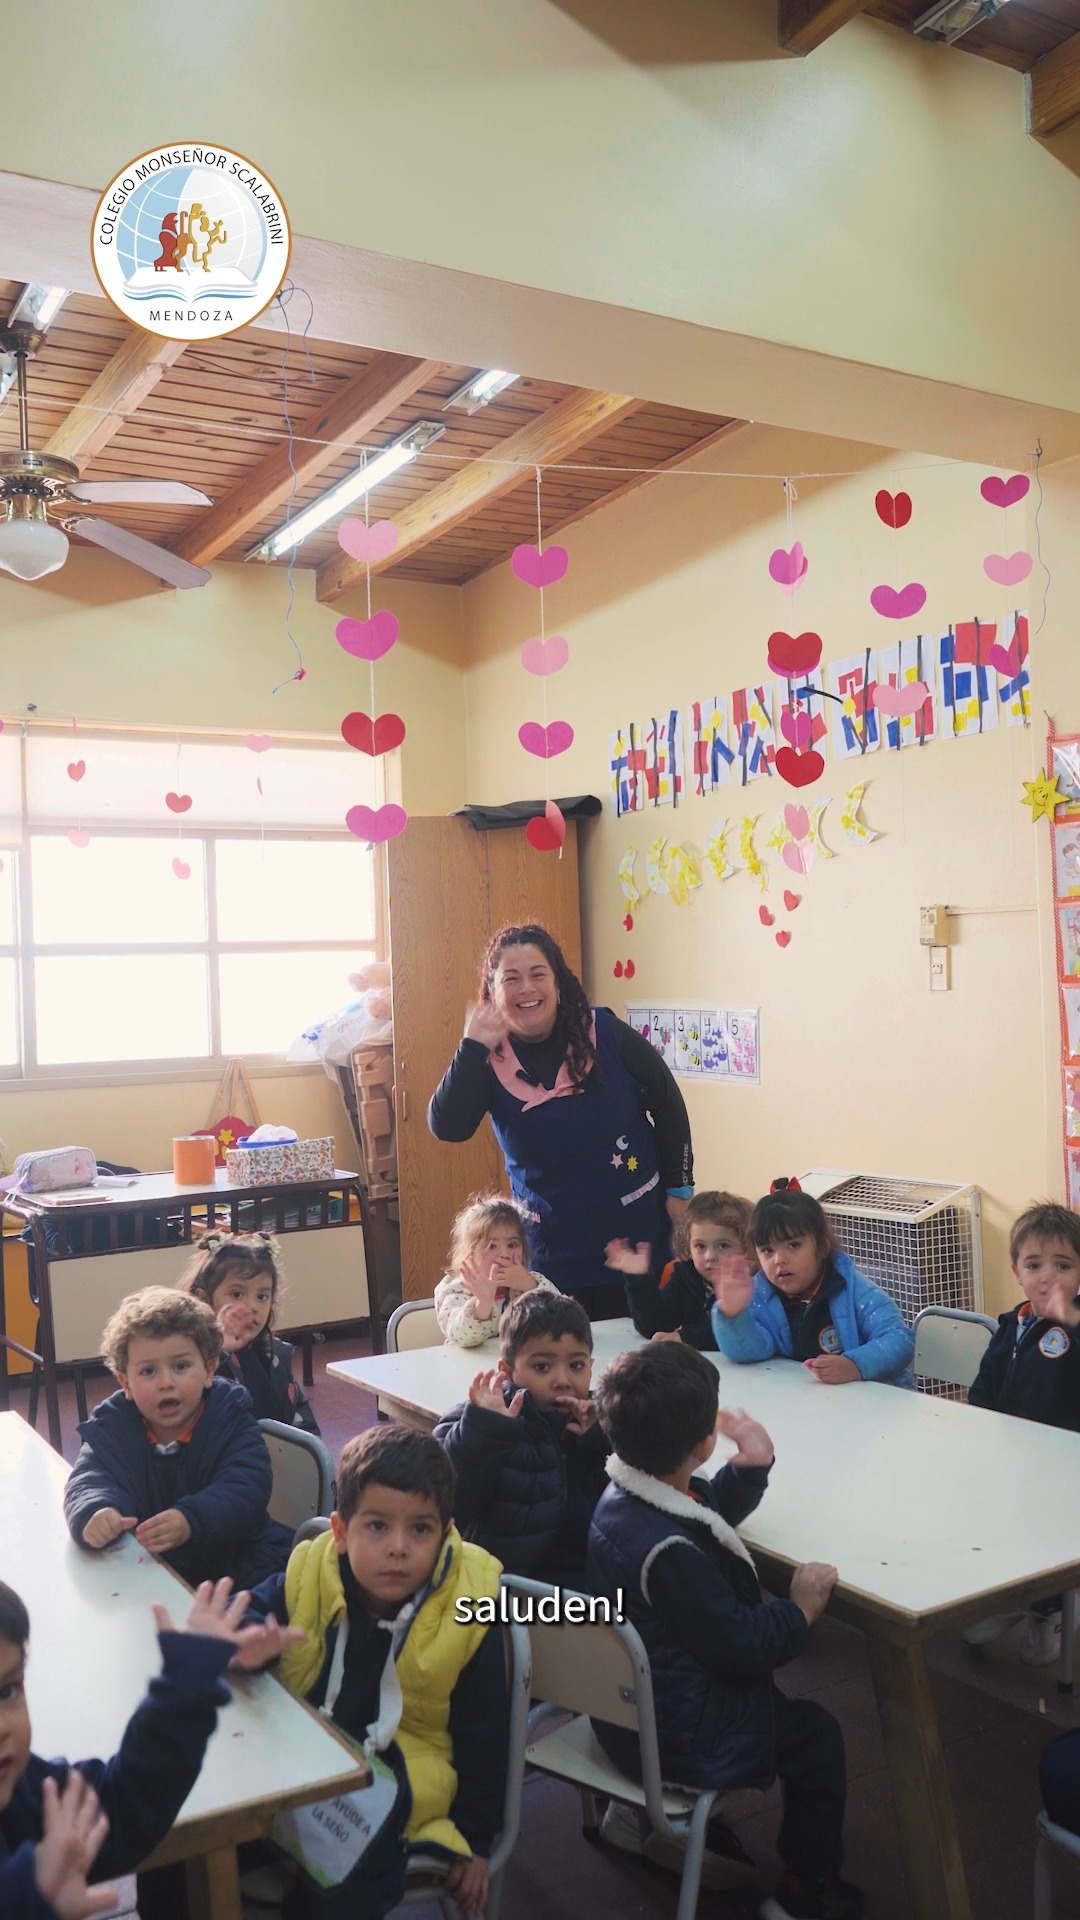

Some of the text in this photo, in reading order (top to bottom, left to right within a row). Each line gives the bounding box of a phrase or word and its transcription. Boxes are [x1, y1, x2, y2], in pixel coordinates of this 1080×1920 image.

[653, 1015, 659, 1031] 2
[678, 1016, 685, 1032] 3
[703, 1017, 711, 1033] 4
[731, 1018, 739, 1035] 5
[311, 1806, 350, 1842] LA SEÑO
[331, 1797, 372, 1836] AYUDE A
